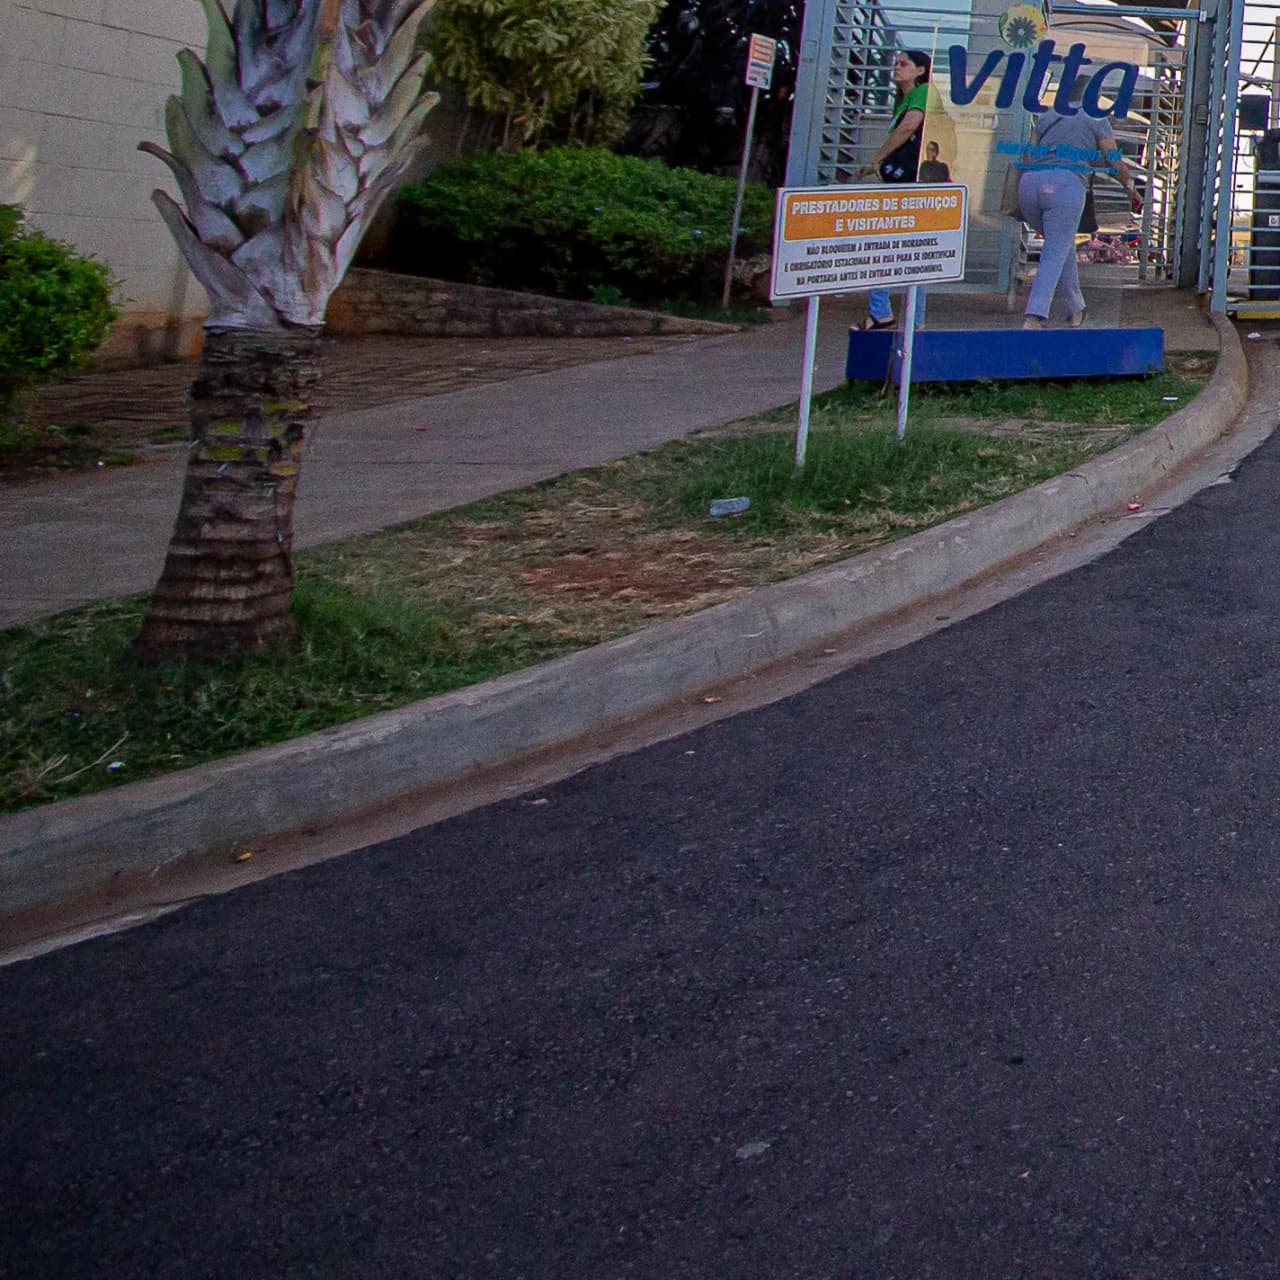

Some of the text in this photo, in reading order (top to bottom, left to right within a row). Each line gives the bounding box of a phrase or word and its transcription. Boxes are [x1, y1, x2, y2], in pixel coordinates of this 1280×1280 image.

[949, 39, 1139, 119] vitta
[791, 195, 958, 215] PRESTADORES DE SERVIÇOS
[835, 215, 916, 232] E VISITANTES
[858, 241, 863, 251] A
[863, 239, 891, 251] ENTRADA
[892, 239, 900, 250] DE
[872, 255, 881, 265] NA
[896, 252, 912, 263] PARA
[913, 251, 920, 261] SE
[921, 249, 956, 261] IDENTIFICAR
[839, 270, 858, 282] ANTES
[859, 268, 868, 280] DE
[869, 267, 892, 279] ENTRAR
[893, 267, 903, 277] NO
